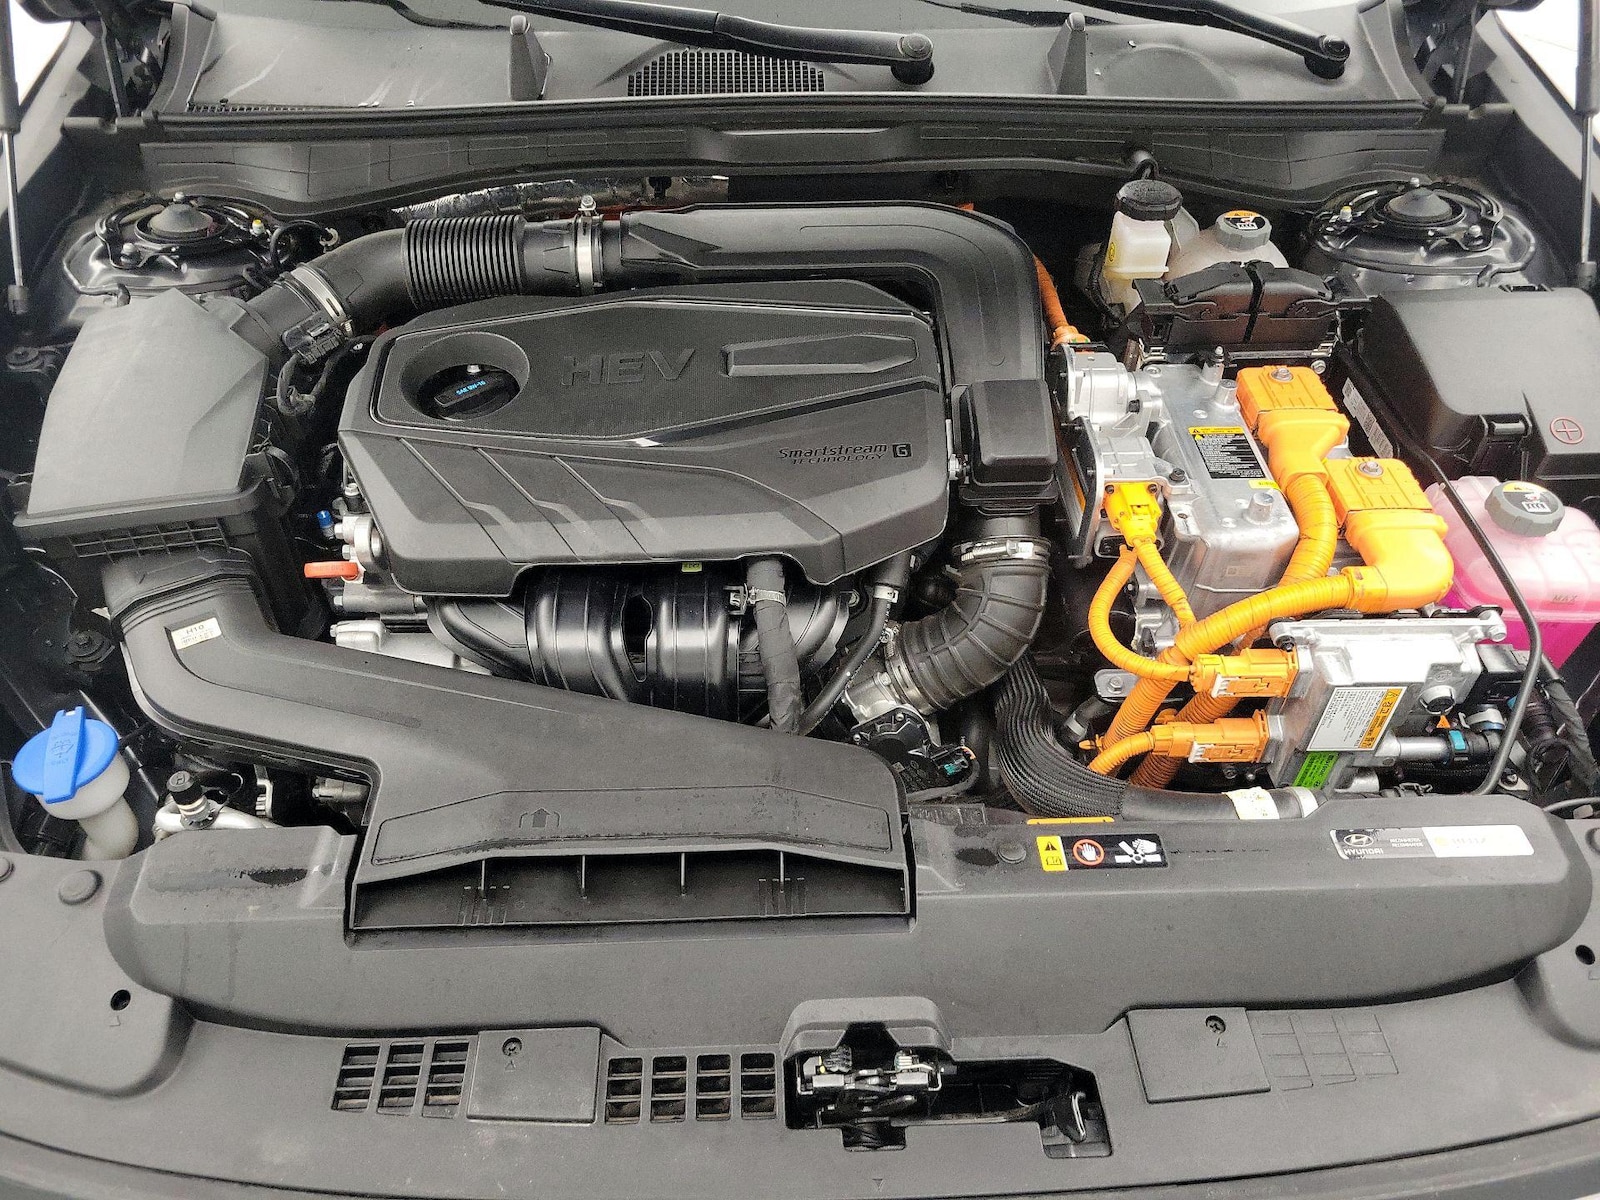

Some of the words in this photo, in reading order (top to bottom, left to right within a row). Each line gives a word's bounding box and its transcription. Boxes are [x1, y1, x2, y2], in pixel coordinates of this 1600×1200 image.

[560, 348, 696, 386] HEV
[779, 444, 887, 459] Smartstream
[893, 444, 911, 458] G
[793, 453, 884, 465] TECHNOLOGY
[1344, 847, 1384, 855] HYUNDAI
